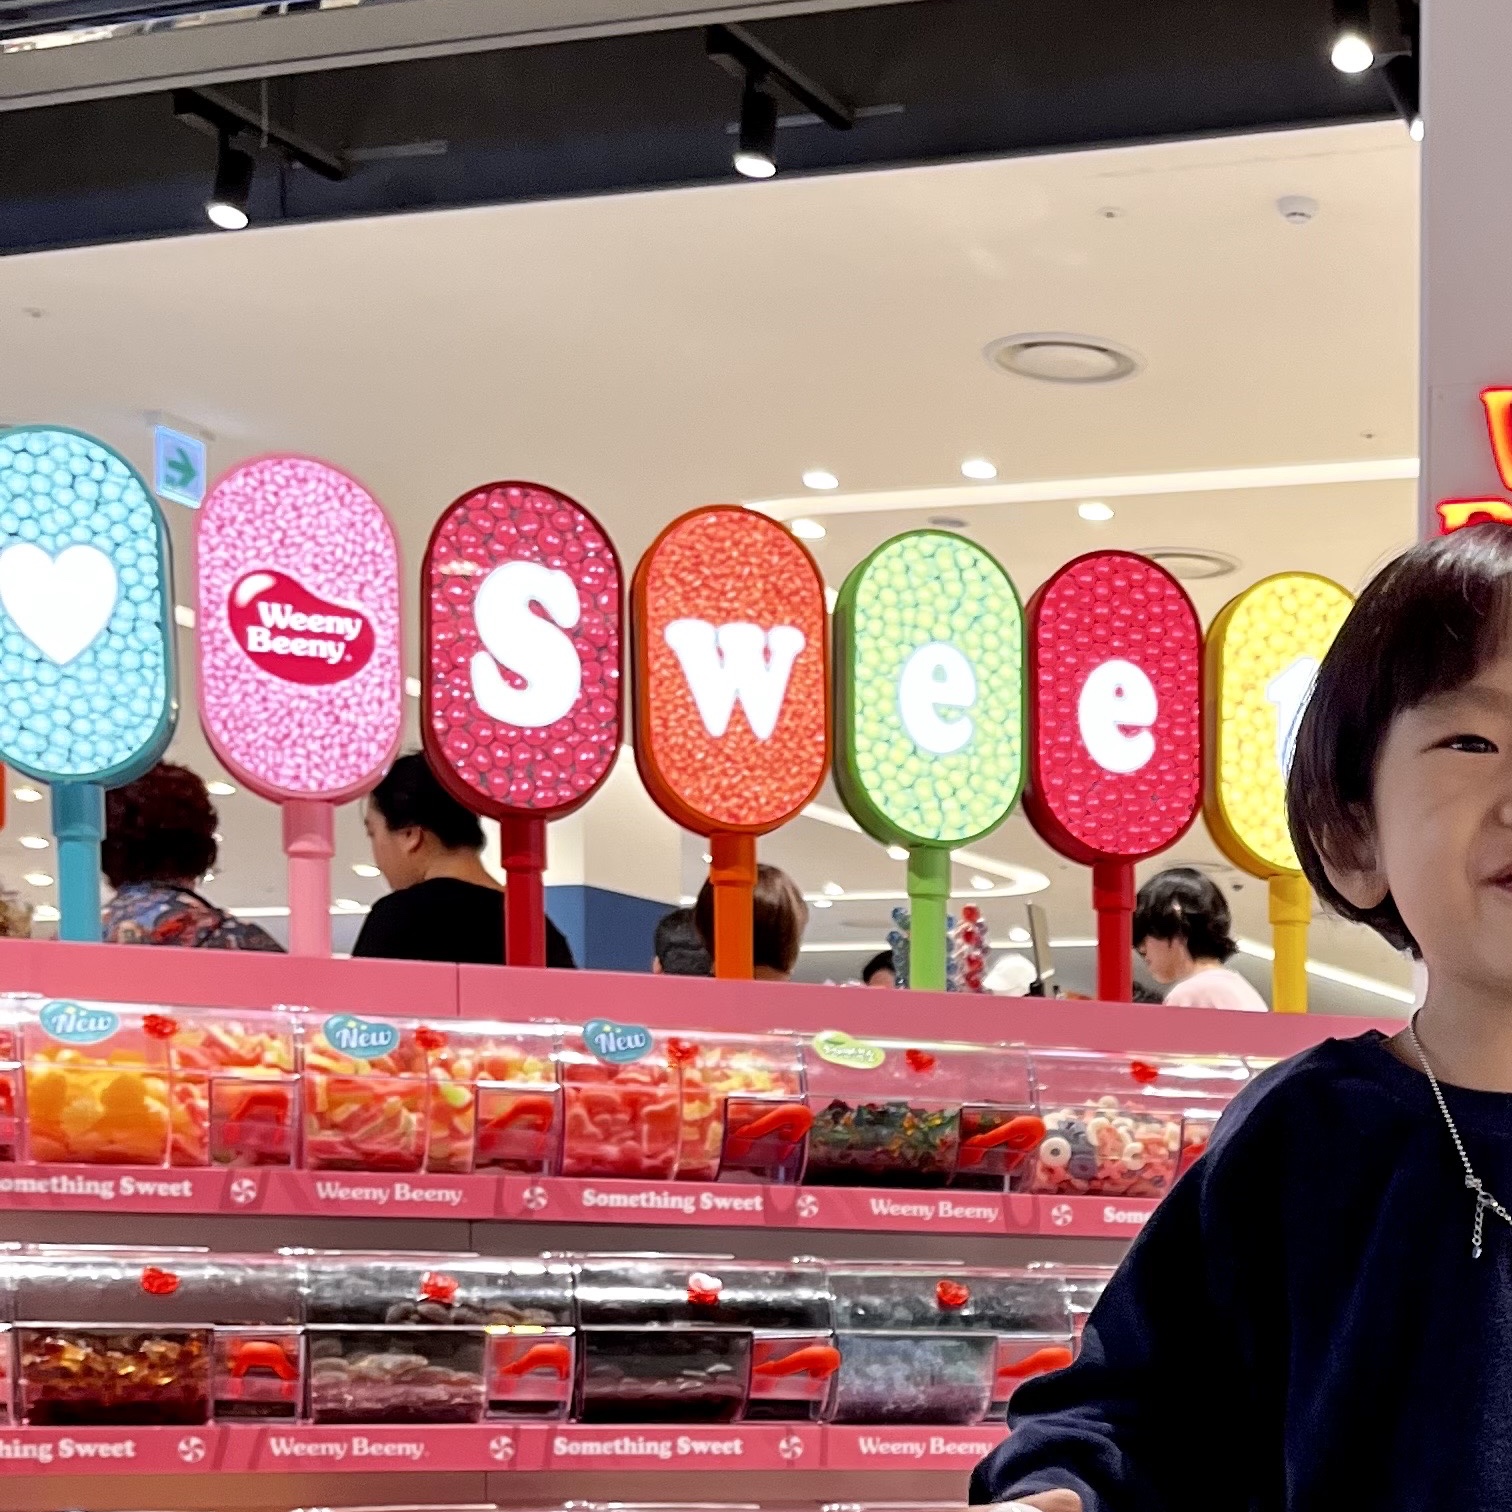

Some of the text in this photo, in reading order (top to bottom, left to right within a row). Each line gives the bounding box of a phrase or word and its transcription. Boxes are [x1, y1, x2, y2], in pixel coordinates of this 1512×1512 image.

[257, 601, 362, 641] Weeny
[52, 1012, 111, 1034] New
[335, 1026, 392, 1049] New
[595, 1031, 646, 1054] New
[0, 1175, 193, 1200] omething Sweet
[316, 1181, 390, 1205] Weeny
[582, 1188, 763, 1214] Something Sweet
[870, 1198, 935, 1221] Weeny
[58, 1438, 136, 1460] Sweet
[269, 1436, 349, 1461] Weeny
[553, 1436, 743, 1459] Something Sweet
[858, 1436, 927, 1459] Weeny
